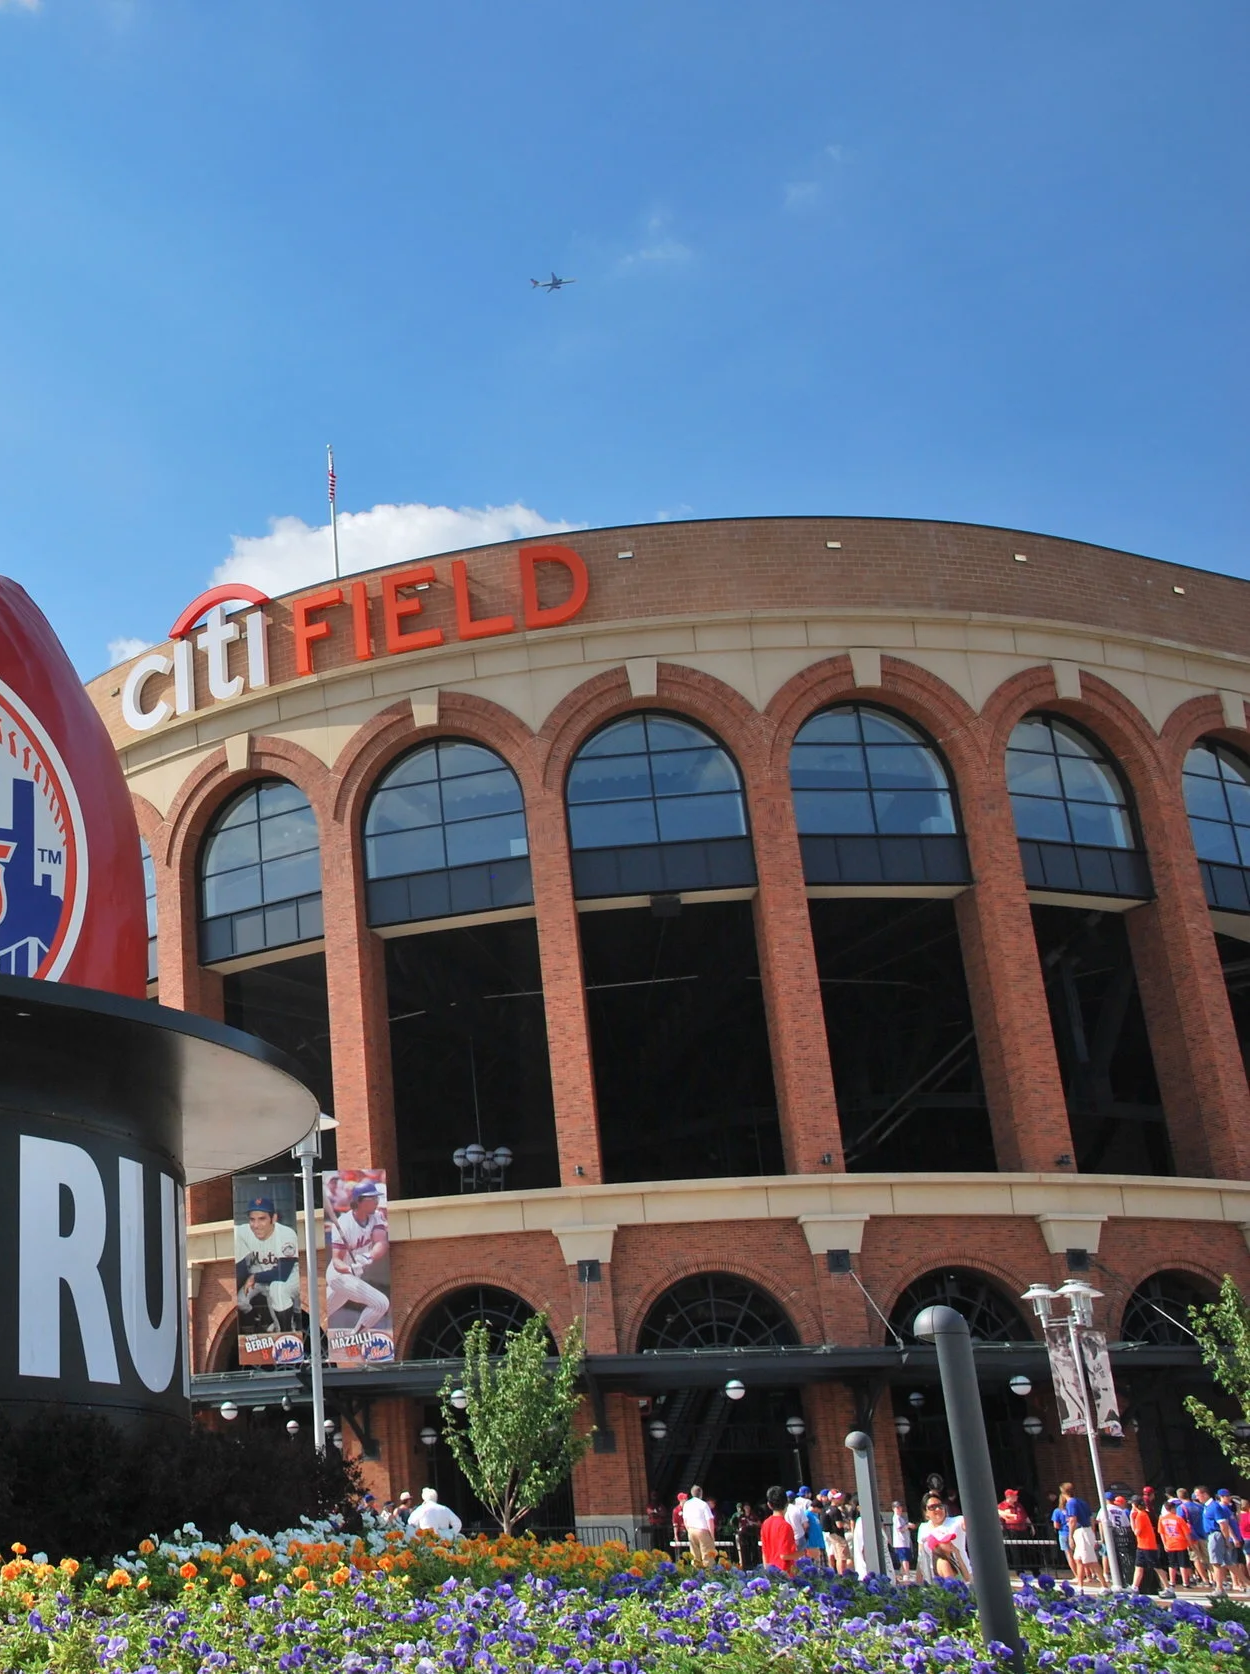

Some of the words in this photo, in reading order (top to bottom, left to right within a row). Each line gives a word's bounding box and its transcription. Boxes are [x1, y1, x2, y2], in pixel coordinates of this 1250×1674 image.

[121, 600, 270, 731] citi
[292, 545, 589, 676] FIELD
[37, 848, 62, 865] TM
[245, 1337, 275, 1353] BERRA
[331, 1332, 372, 1350] MAZZILLI
[1114, 1516, 1121, 1527] 5
